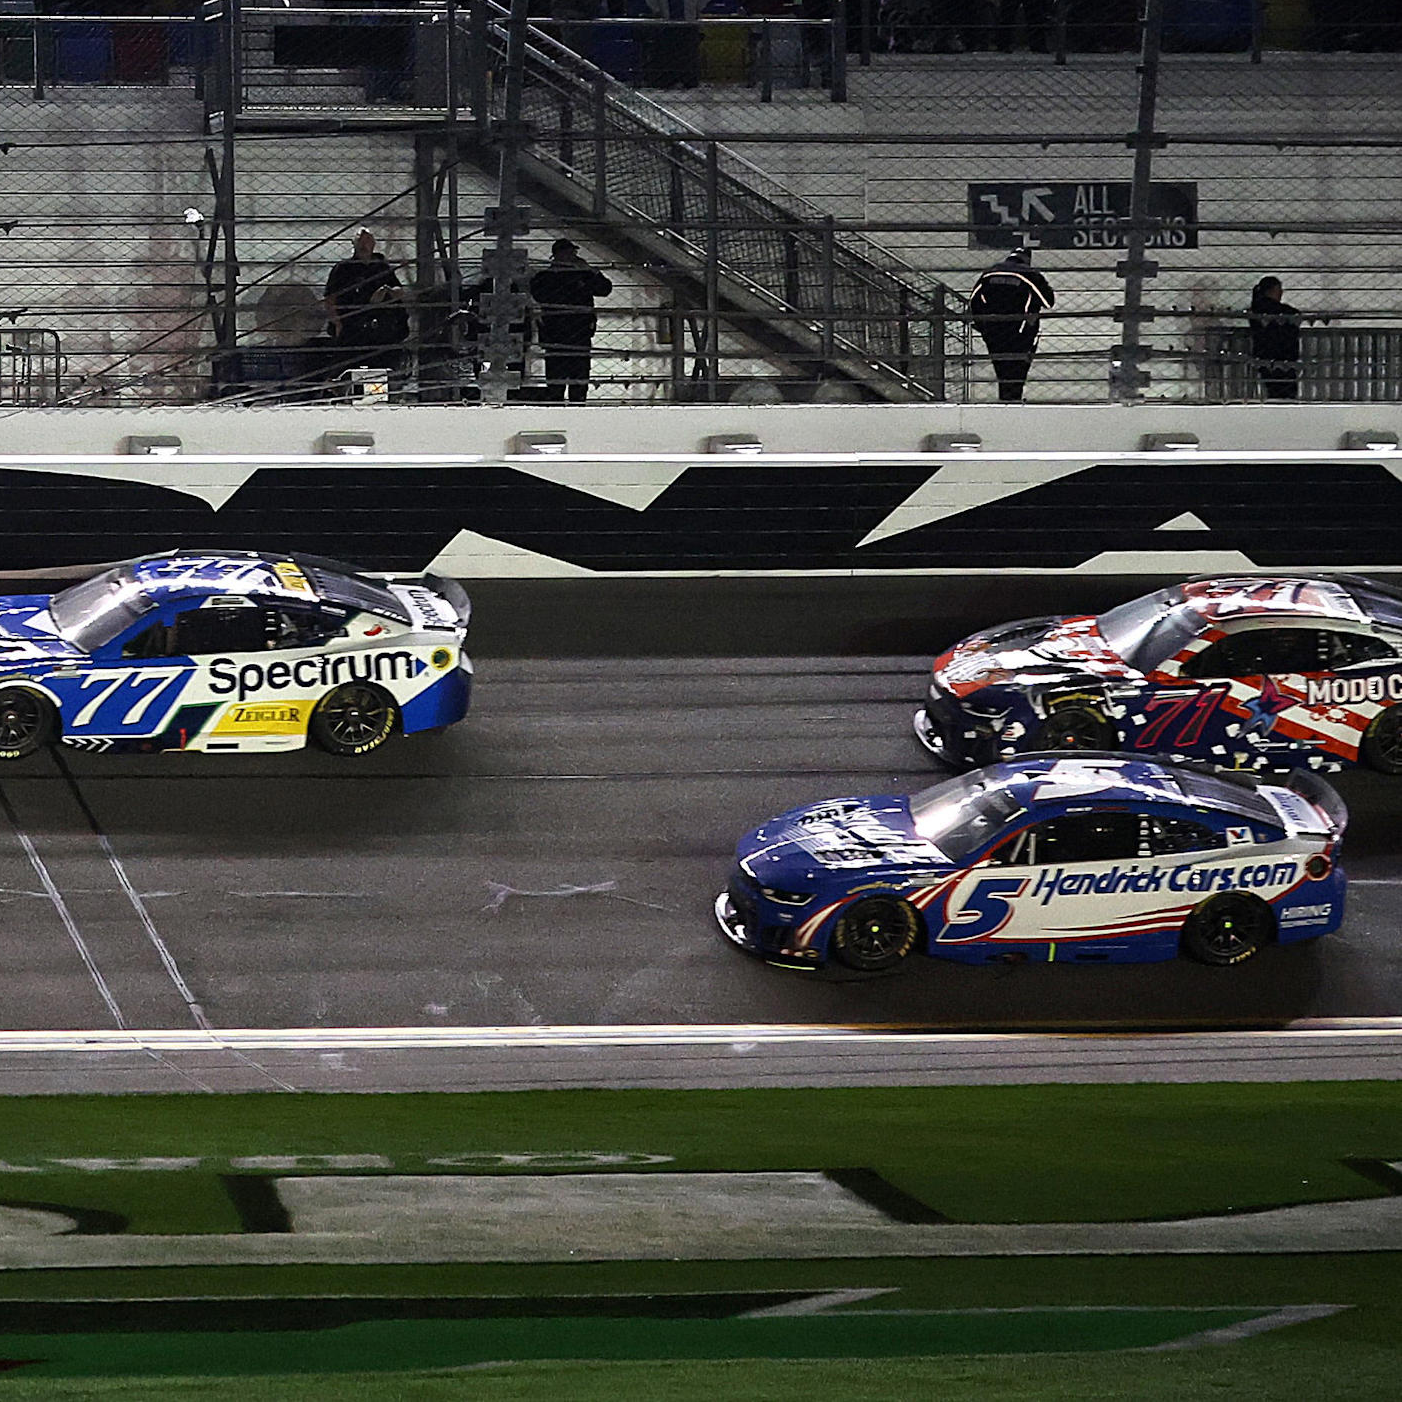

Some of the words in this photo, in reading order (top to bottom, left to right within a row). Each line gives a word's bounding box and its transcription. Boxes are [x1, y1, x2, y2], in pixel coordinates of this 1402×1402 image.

[1073, 185, 1115, 215] ALL
[72, 669, 184, 726] 77
[208, 651, 416, 701] Spectrum
[1308, 676, 1385, 705] MODO
[233, 708, 301, 722] ZEIGLER
[1135, 683, 1231, 748] 71
[937, 878, 1030, 941] 5
